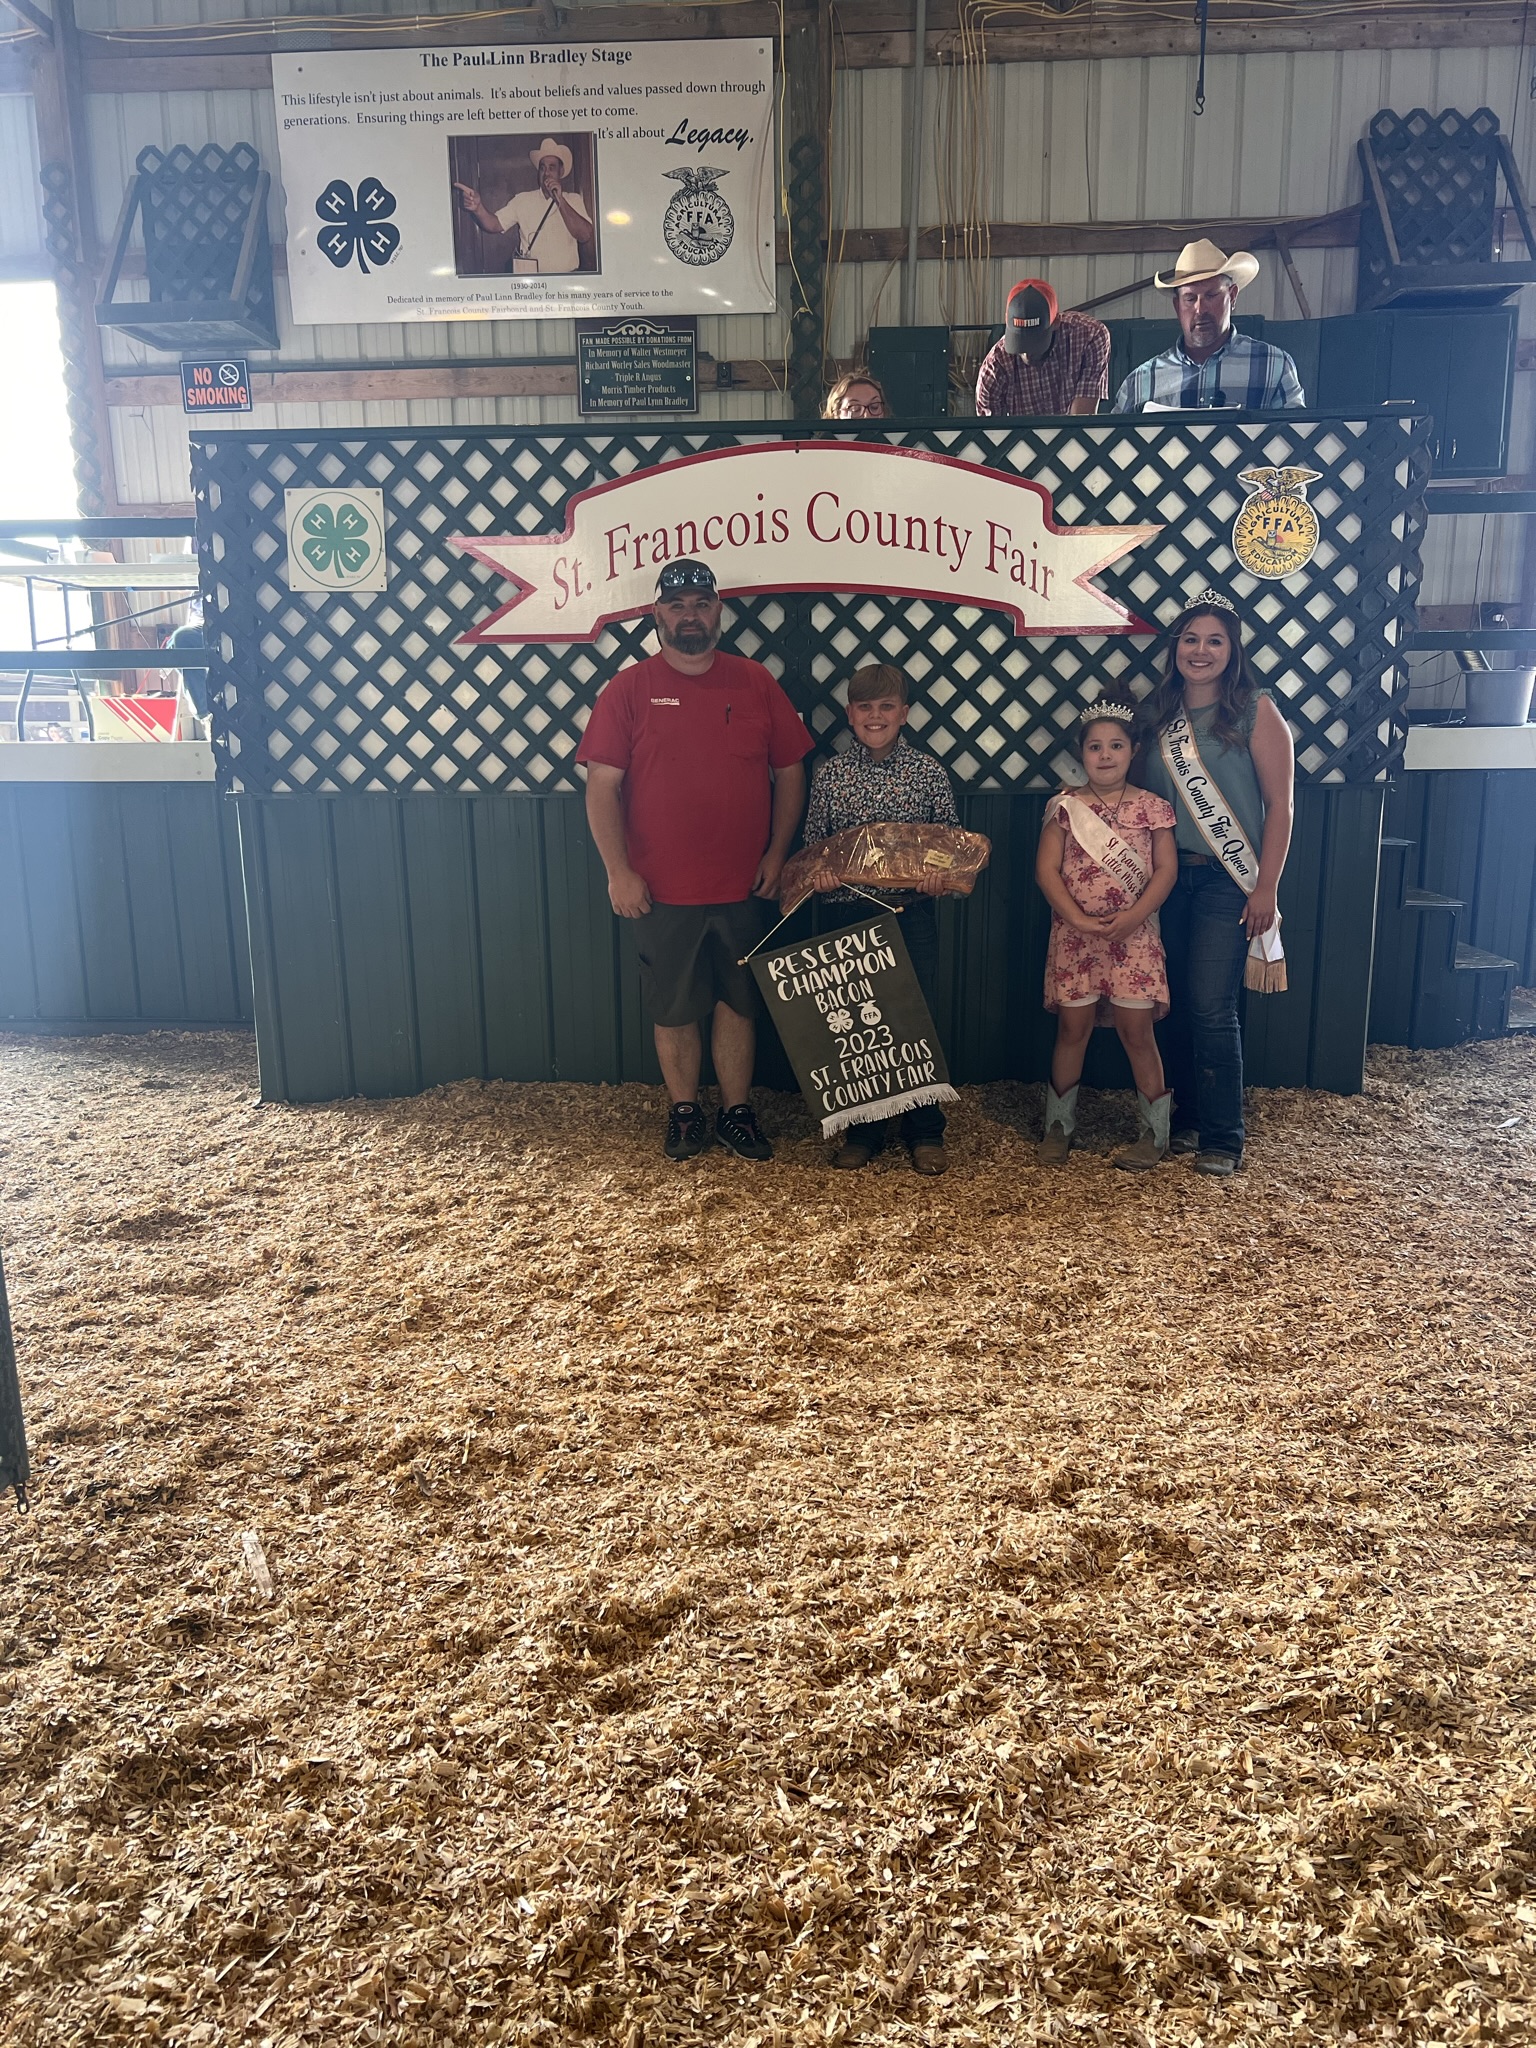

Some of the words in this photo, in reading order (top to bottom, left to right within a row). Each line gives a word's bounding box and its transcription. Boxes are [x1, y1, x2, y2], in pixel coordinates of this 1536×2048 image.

[420, 53, 448, 67] The
[453, 52, 486, 67] Paul
[490, 51, 525, 65] Linn
[530, 49, 587, 66] Bradley
[592, 48, 632, 65] Stage
[282, 94, 306, 106] This
[309, 92, 351, 107] lifestyle
[354, 91, 376, 103] isn't
[379, 91, 400, 104] just
[402, 90, 434, 102] about
[437, 89, 484, 101] animals.
[491, 87, 507, 99] It's
[510, 86, 541, 98] about
[544, 84, 581, 97] beliefs
[583, 84, 604, 96] and
[607, 83, 642, 96] values
[645, 82, 683, 97] passed
[686, 81, 717, 94] down
[720, 80, 766, 95] through
[283, 115, 350, 130] generations.
[357, 112, 406, 126] Ensuring
[409, 110, 445, 124] things
[447, 112, 464, 121] are
[467, 109, 485, 120] left
[488, 108, 522, 120] better
[524, 107, 535, 119] of
[538, 107, 569, 118] those
[571, 107, 587, 120] yet
[591, 106, 602, 117] to
[605, 107, 638, 117] come.
[598, 127, 613, 140] It's
[616, 126, 630, 139] all
[632, 126, 665, 138] about
[665, 118, 754, 153] Legacy.
[325, 191, 346, 215] H
[365, 188, 385, 211] H
[675, 201, 723, 228] AGRICULTURAL
[687, 212, 714, 225] FFA
[327, 233, 347, 255] H
[370, 231, 391, 253] H
[679, 239, 720, 255] EDUCATION
[387, 295, 423, 304] Dedicated
[425, 295, 433, 303] in
[435, 295, 464, 304] memory
[467, 293, 474, 302] of
[476, 293, 492, 301] Paul
[494, 293, 512, 301] Linn
[515, 292, 542, 301] Bradley
[545, 292, 555, 300] for
[557, 291, 568, 299] his
[571, 292, 591, 300] many
[593, 292, 613, 300] years
[615, 290, 623, 298] of
[624, 290, 650, 298] service
[661, 289, 673, 297] the
[596, 337, 610, 345] MADE
[637, 336, 645, 344] BY
[646, 336, 675, 344] DONATIONS
[677, 335, 692, 343] FROM
[585, 361, 609, 370] Richard
[611, 360, 632, 370] Worley
[634, 360, 650, 369] Sales
[652, 359, 691, 369] Woodmaster
[588, 349, 595, 357] In
[597, 348, 621, 358] Memory
[623, 347, 630, 357] of
[631, 347, 651, 356] Walter
[653, 347, 687, 357] Westmeyer
[193, 367, 212, 385] NO
[615, 373, 634, 383] Triple
[641, 372, 661, 382] Angus
[187, 386, 247, 405] SMOKING
[601, 385, 622, 394] Morris
[623, 385, 646, 394] Timber
[648, 384, 676, 393] Products
[590, 398, 596, 407] In
[598, 398, 623, 407] Memory
[624, 397, 631, 406] of
[632, 397, 646, 406] Paul
[648, 397, 663, 406] Lynn
[664, 397, 688, 406] Bradley
[311, 513, 326, 530] H
[343, 513, 358, 530] H
[1248, 506, 1304, 536] AGRICULTURAL
[1263, 517, 1294, 532] FFA
[311, 544, 326, 561] H
[346, 547, 361, 563] H
[552, 556, 592, 610] St.
[605, 493, 790, 582] Francois
[806, 491, 972, 573] County
[986, 520, 1055, 601] Fair
[1250, 549, 1298, 566] EDUCATION
[1168, 719, 1186, 738] St.
[1169, 735, 1190, 776] Francois
[1186, 776, 1215, 820] County
[1208, 815, 1232, 839] Fair
[1221, 839, 1249, 876] Queen
[1102, 853, 1122, 875] Little
[1121, 871, 1137, 893] Miss
[767, 924, 888, 982] RESERVE
[777, 946, 896, 1001] CHAMPION
[814, 978, 874, 1014] BACON
[863, 1011, 878, 1020] FFA
[834, 1025, 894, 1059] 2023
[810, 1065, 837, 1091] ST.
[840, 1038, 933, 1080] FRANCOIS
[822, 1072, 891, 1112] COUNTY
[896, 1060, 937, 1089] FAIR
